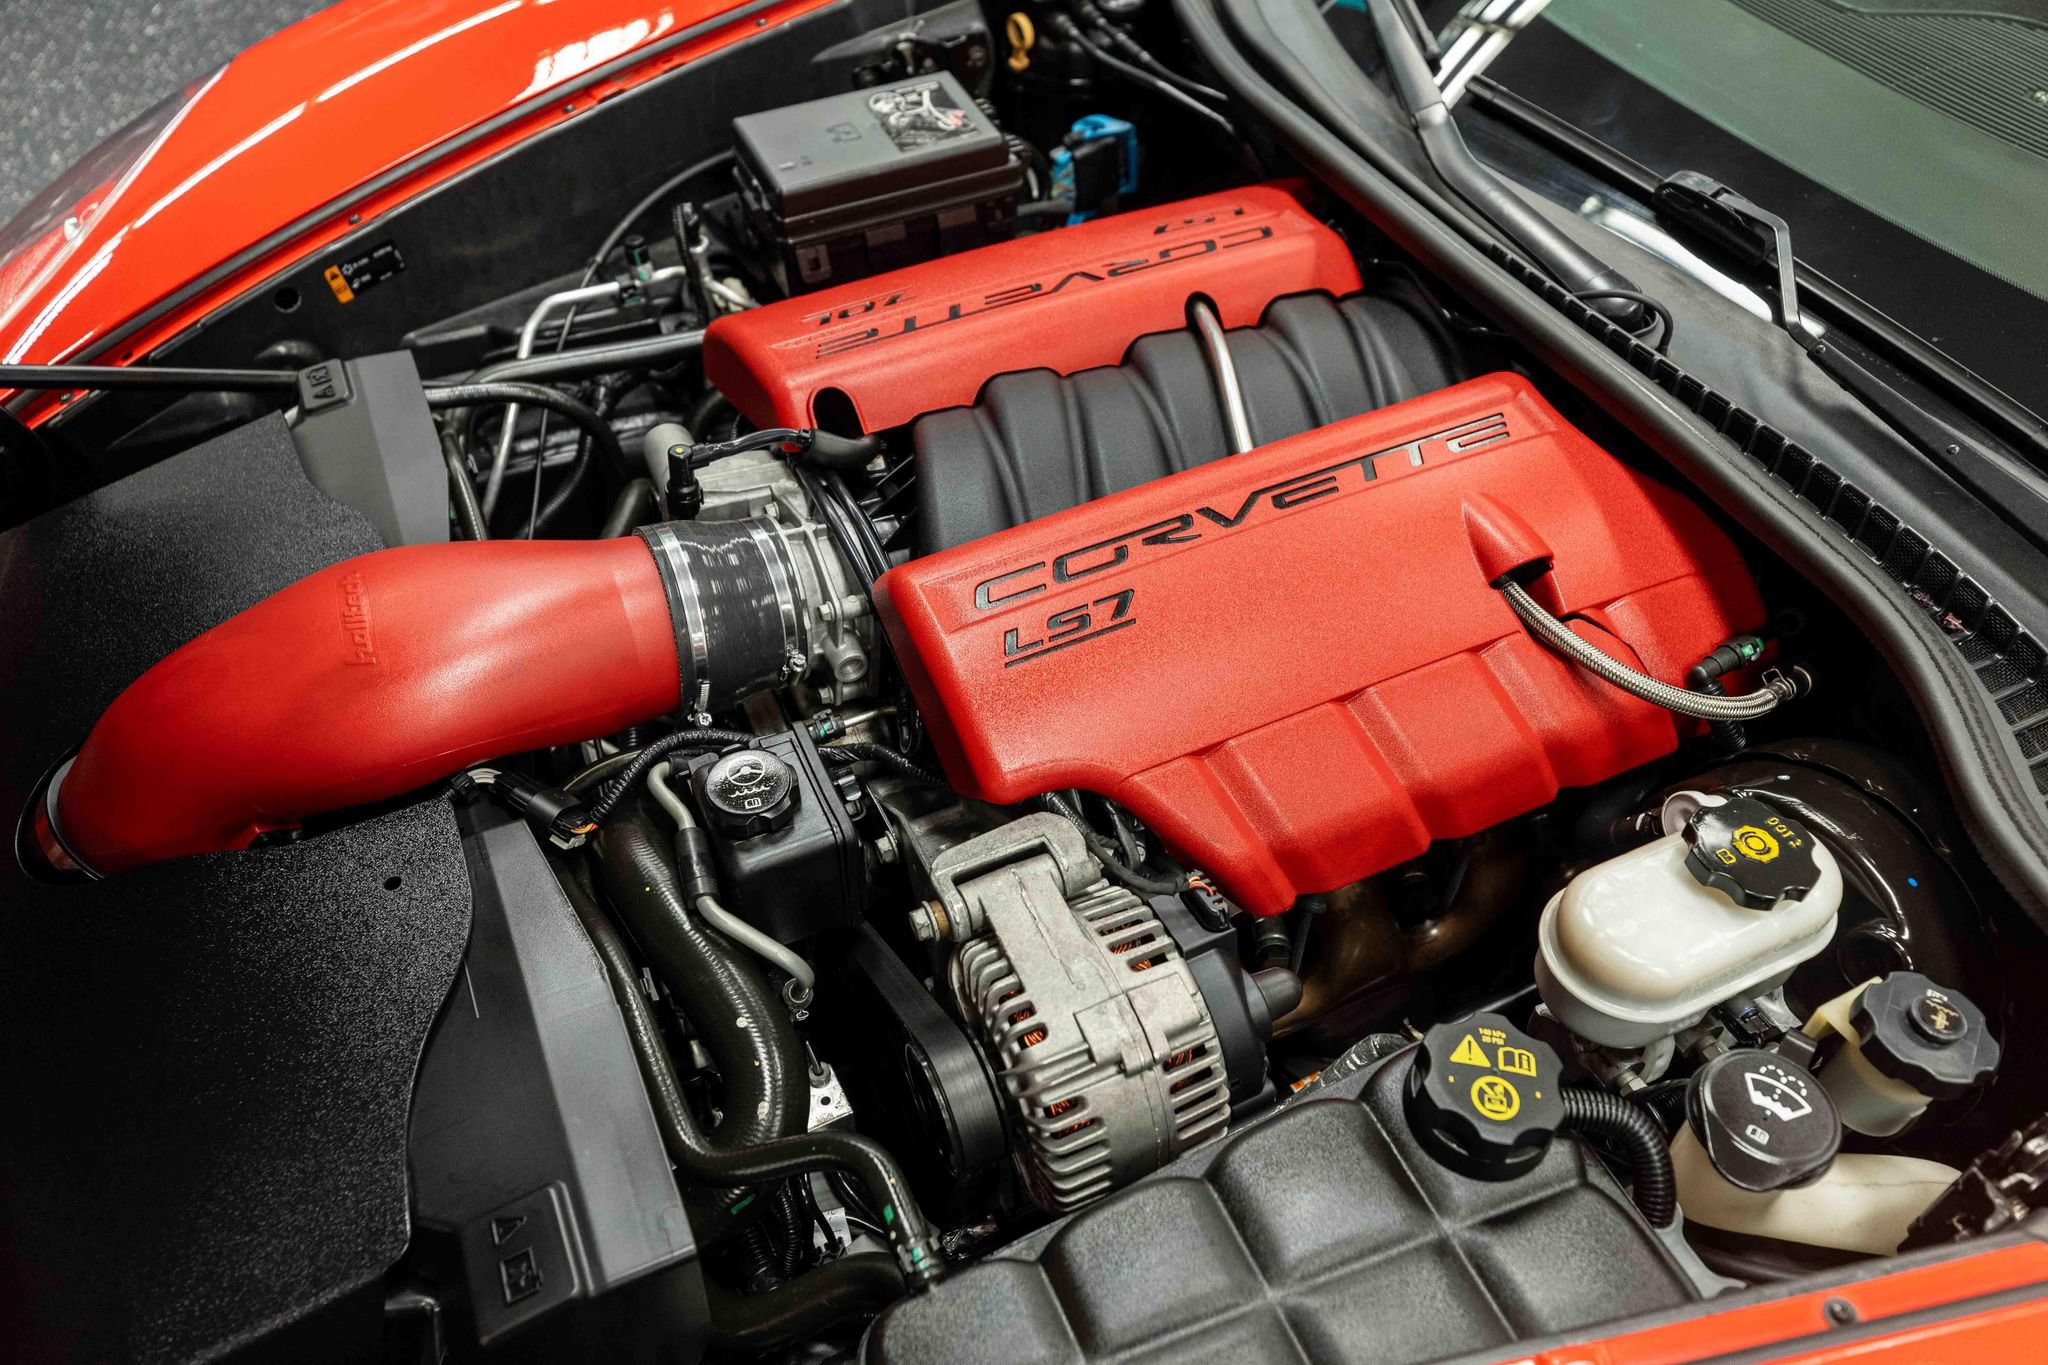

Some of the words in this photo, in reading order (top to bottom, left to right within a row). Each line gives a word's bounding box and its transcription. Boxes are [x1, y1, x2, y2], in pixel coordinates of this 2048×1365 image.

[815, 226, 1272, 359] CORVETTE
[975, 412, 1509, 610] CORVETTE
[1004, 588, 1135, 657] LS7
[1766, 817, 1794, 838] DOT
